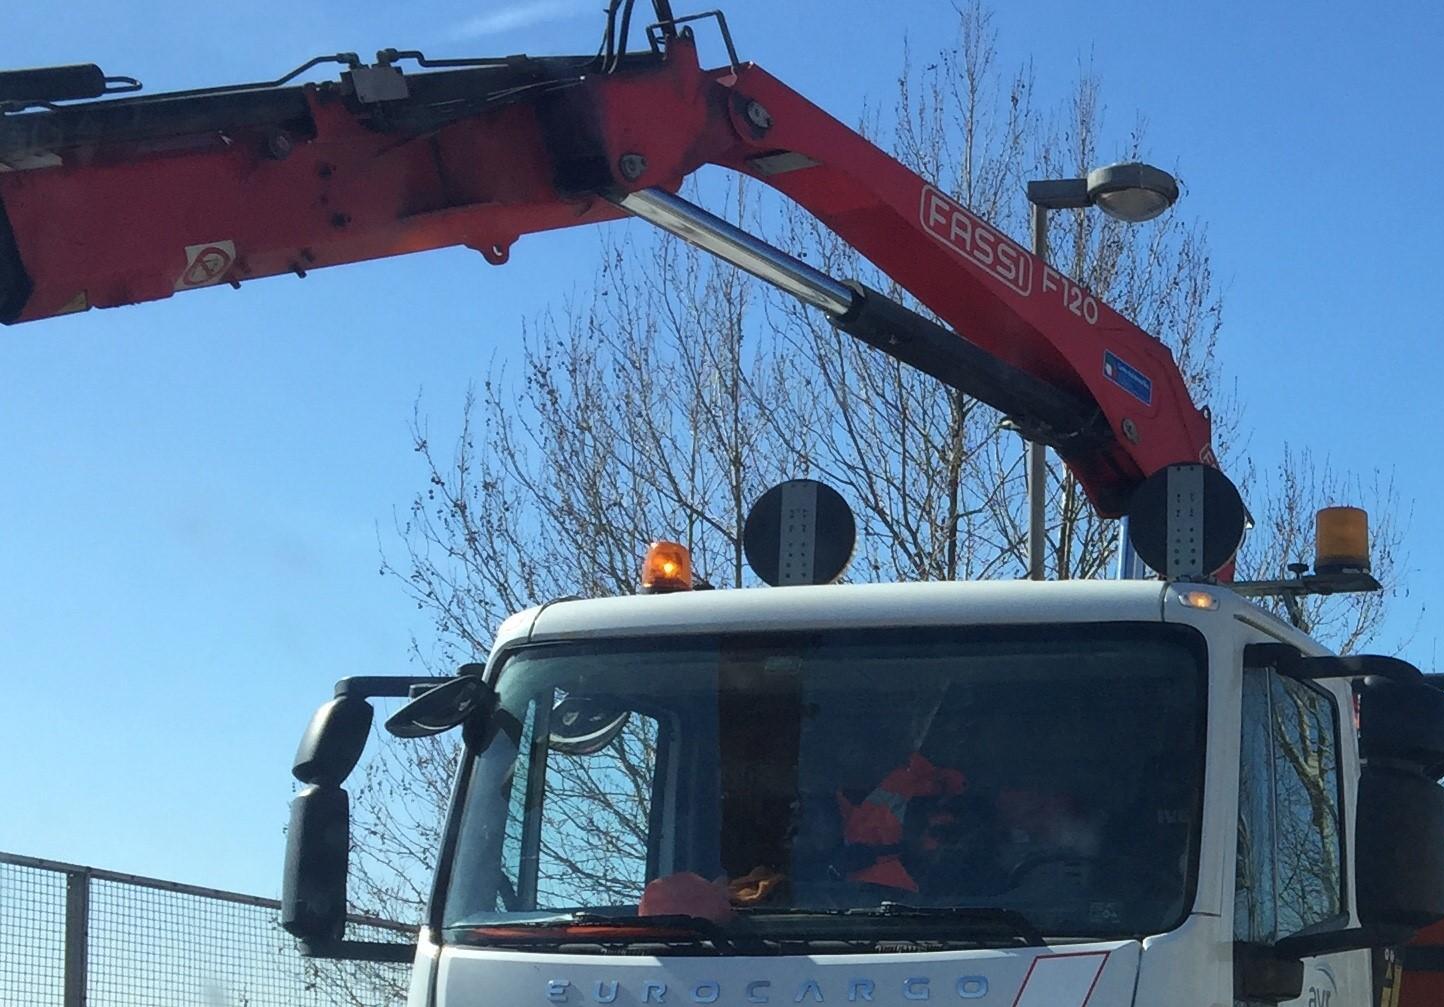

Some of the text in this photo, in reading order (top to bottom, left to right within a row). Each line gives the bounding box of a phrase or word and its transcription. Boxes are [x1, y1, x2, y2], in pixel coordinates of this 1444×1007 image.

[929, 195, 1098, 325] FASSI F120
[546, 975, 989, 1003] EUROCARGO
